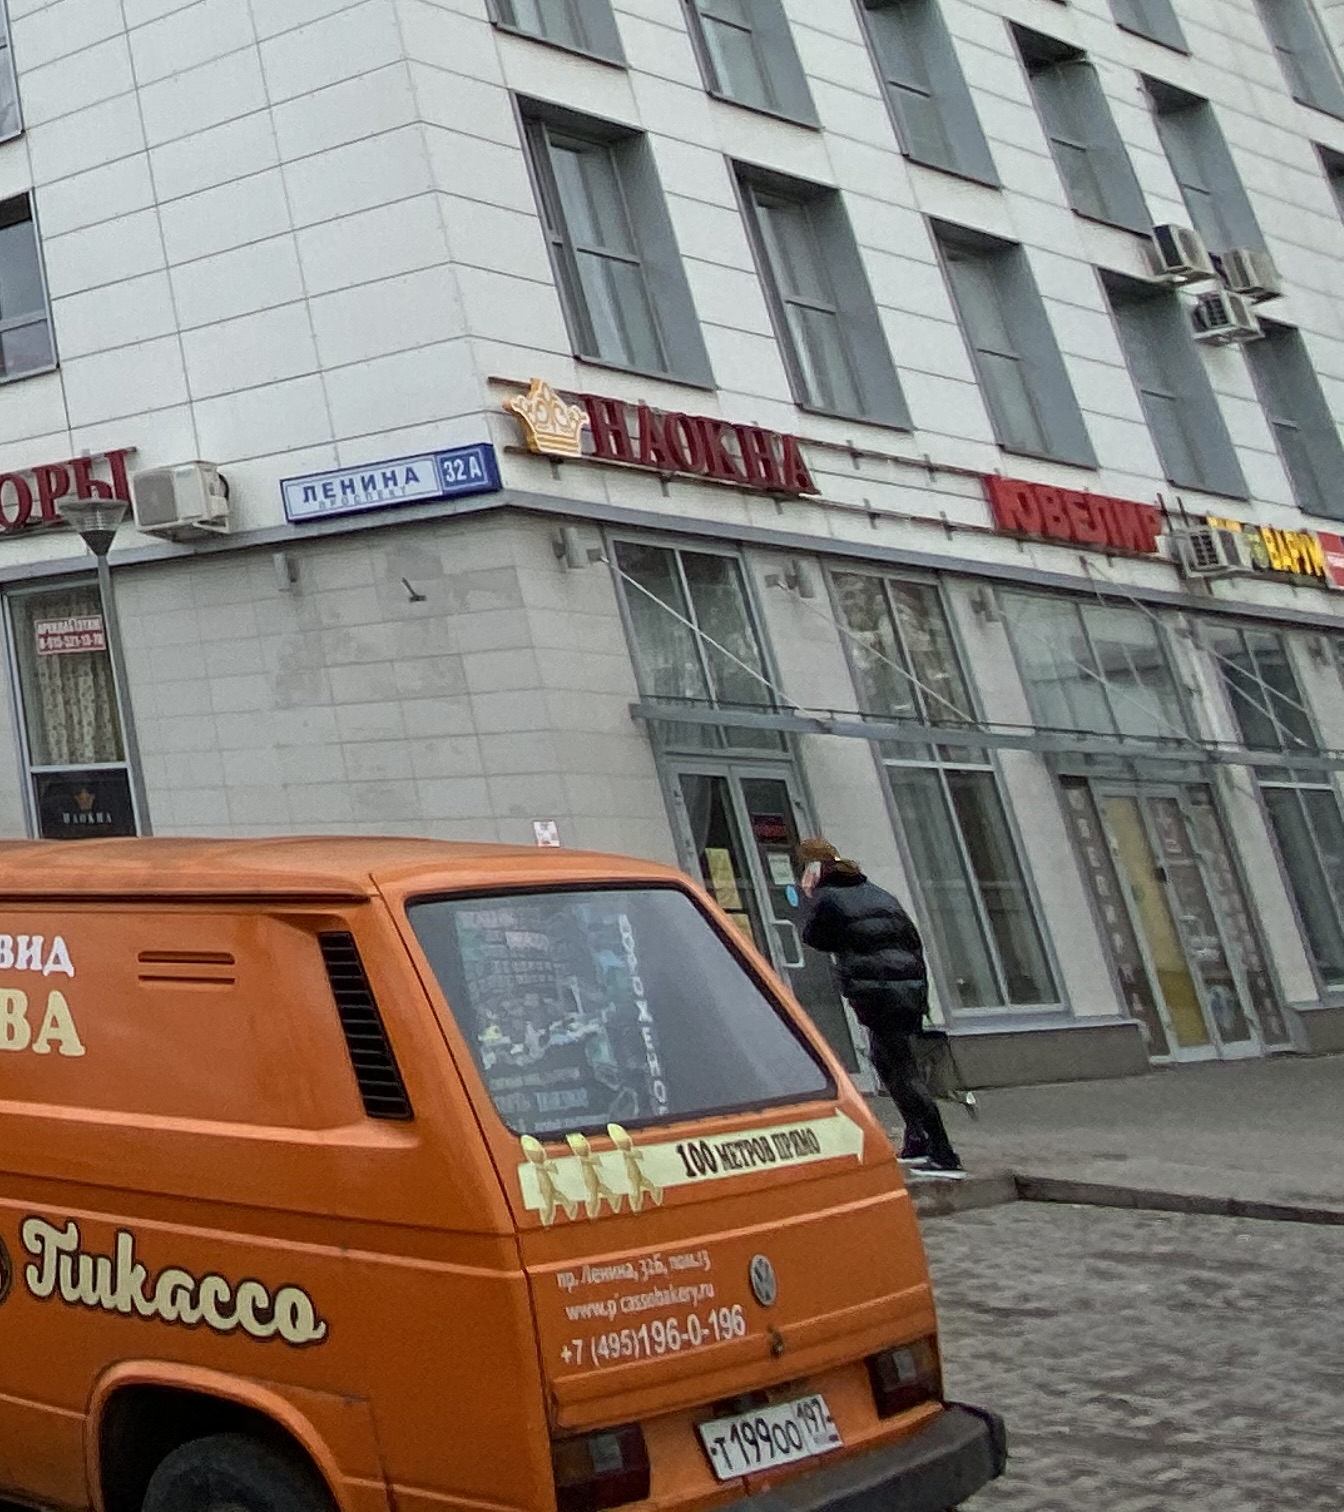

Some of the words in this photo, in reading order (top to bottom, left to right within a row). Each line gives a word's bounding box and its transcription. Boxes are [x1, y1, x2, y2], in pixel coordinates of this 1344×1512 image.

[579, 393, 822, 495] НАОКНА
[302, 466, 420, 503] ЛЕНИНА
[318, 485, 407, 510] ПРОСПЕКТ
[676, 1140, 719, 1178] 100
[715, 1135, 776, 1171] МЕТРОВ
[770, 1128, 821, 1161] ПРЯМО
[21, 1217, 327, 1344] Пикассо
[565, 1282, 715, 1322] www.pcassobakery.ru
[560, 1338, 583, 1367] +7
